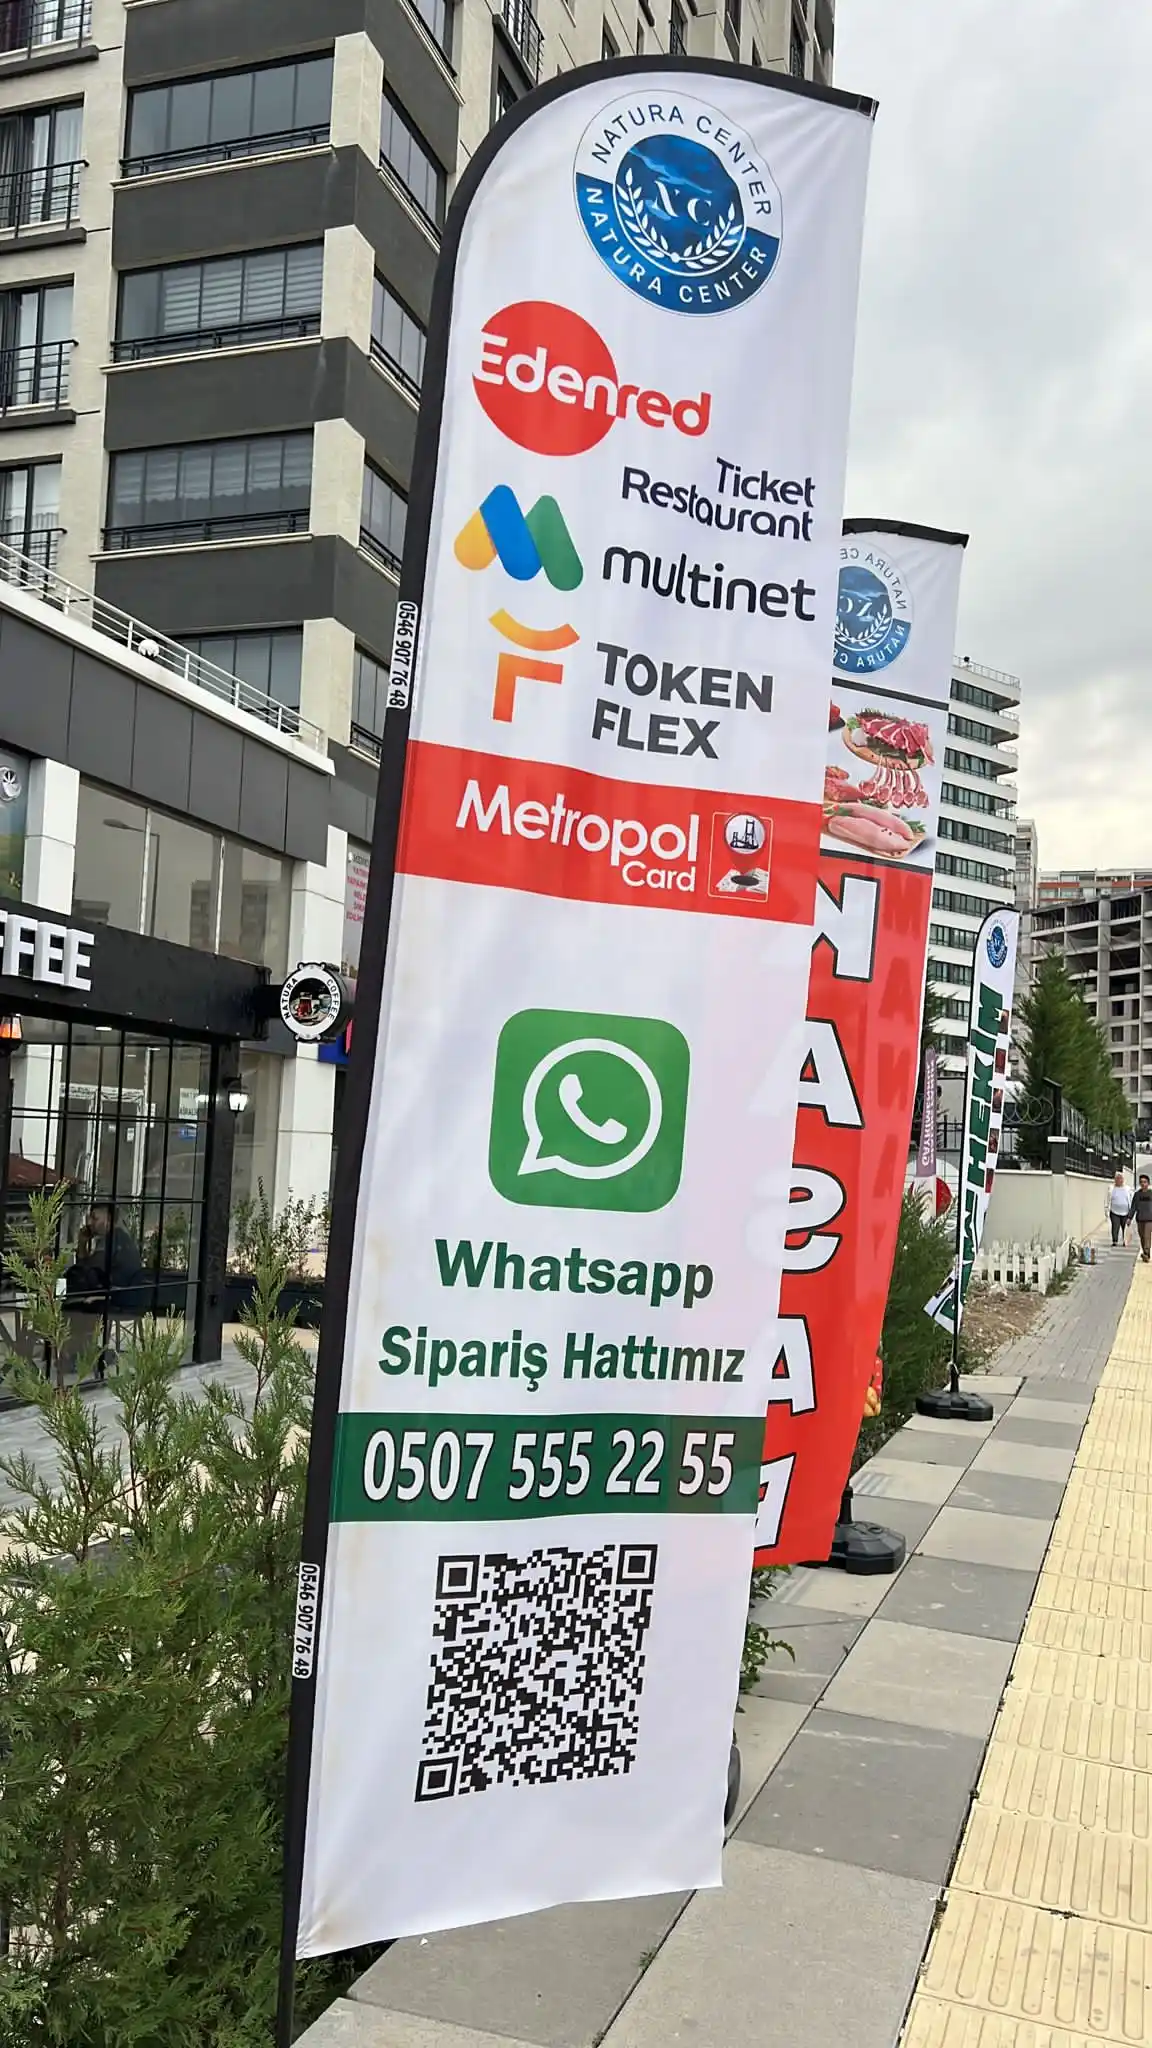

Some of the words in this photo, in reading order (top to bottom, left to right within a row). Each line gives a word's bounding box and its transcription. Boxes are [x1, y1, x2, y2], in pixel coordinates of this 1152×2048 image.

[591, 104, 684, 164] NATURA
[696, 115, 771, 215] CENTER
[586, 187, 662, 295] NATURA
[679, 246, 767, 304] CENTER
[473, 333, 711, 436] Edenred
[622, 466, 813, 541] Restaurant
[716, 457, 815, 508] Ticket
[602, 546, 816, 621] multinet
[396, 602, 416, 637] 0546
[391, 670, 408, 687] 76
[394, 640, 412, 666] 907
[596, 642, 773, 713] TOKEN
[389, 689, 406, 707] 48
[592, 698, 720, 759] FLEX
[455, 779, 699, 866] Metropol
[621, 860, 696, 892] Card
[282, 978, 298, 1019] NATURA
[326, 979, 339, 1020] COFFEE
[435, 1238, 713, 1308] Whatsapp
[379, 1326, 548, 1391] Sipariş
[563, 1332, 745, 1383] Hattımız
[362, 1430, 495, 1501] 0507
[508, 1430, 593, 1500] 555
[605, 1429, 665, 1496] 22
[678, 1431, 736, 1496] 55
[300, 1564, 317, 1600] 0546
[296, 1637, 311, 1654] 76
[298, 1605, 314, 1632] 907
[294, 1659, 309, 1677] 48
